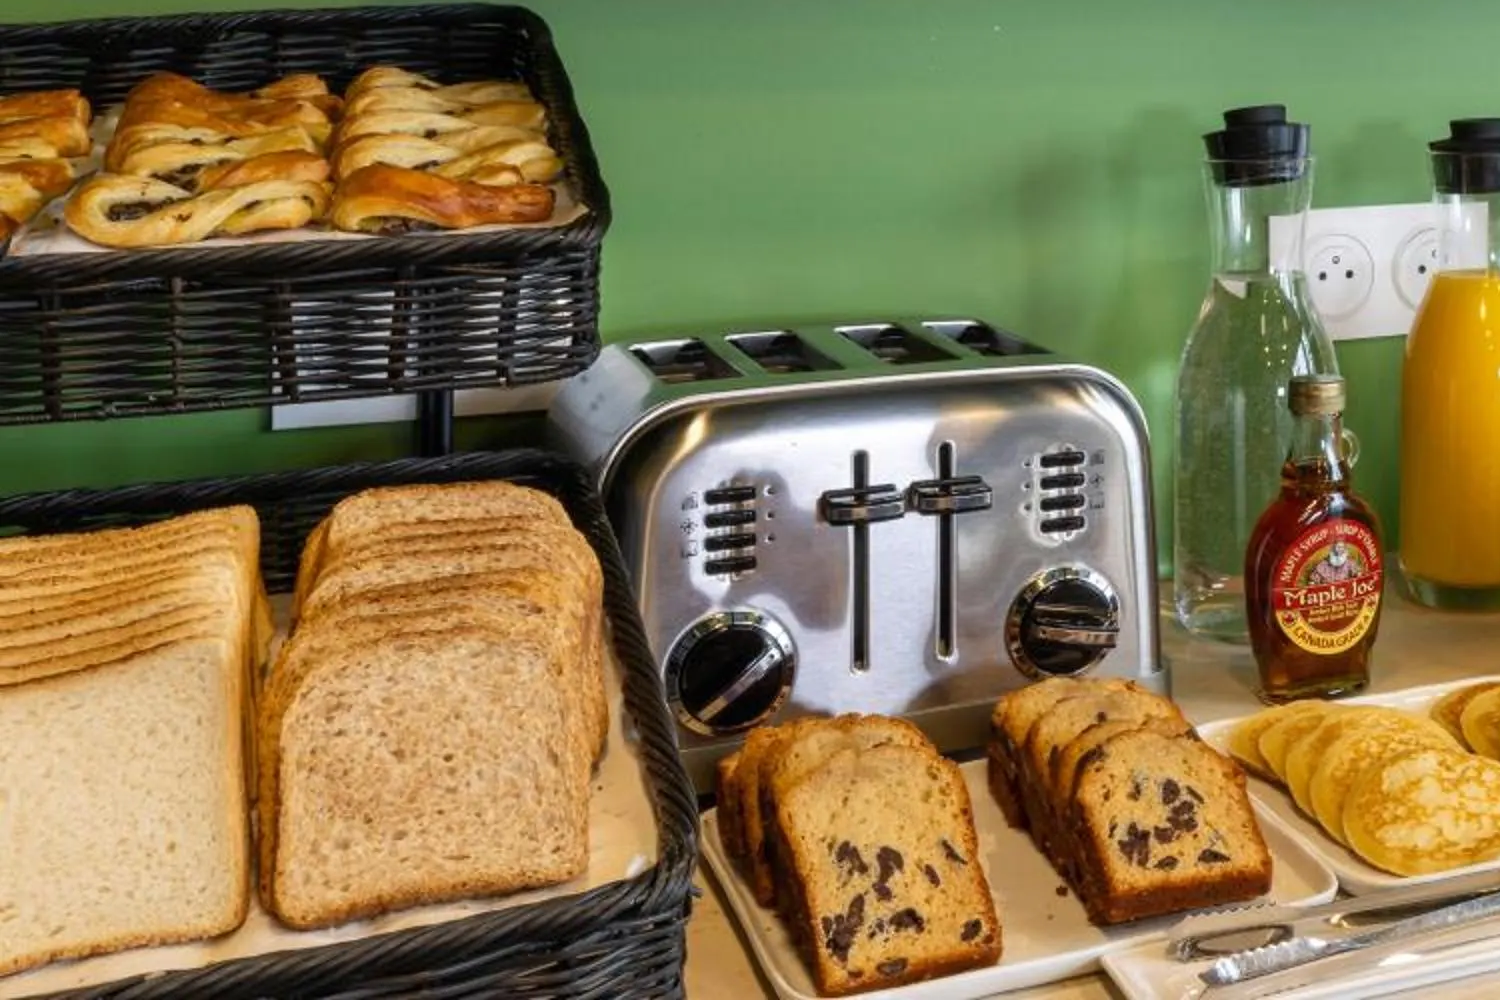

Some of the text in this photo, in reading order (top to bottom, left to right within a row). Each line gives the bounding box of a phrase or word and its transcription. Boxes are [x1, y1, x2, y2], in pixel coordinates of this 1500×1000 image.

[1283, 579, 1375, 607] Maple Joe
[1293, 626, 1334, 649] CANADA
